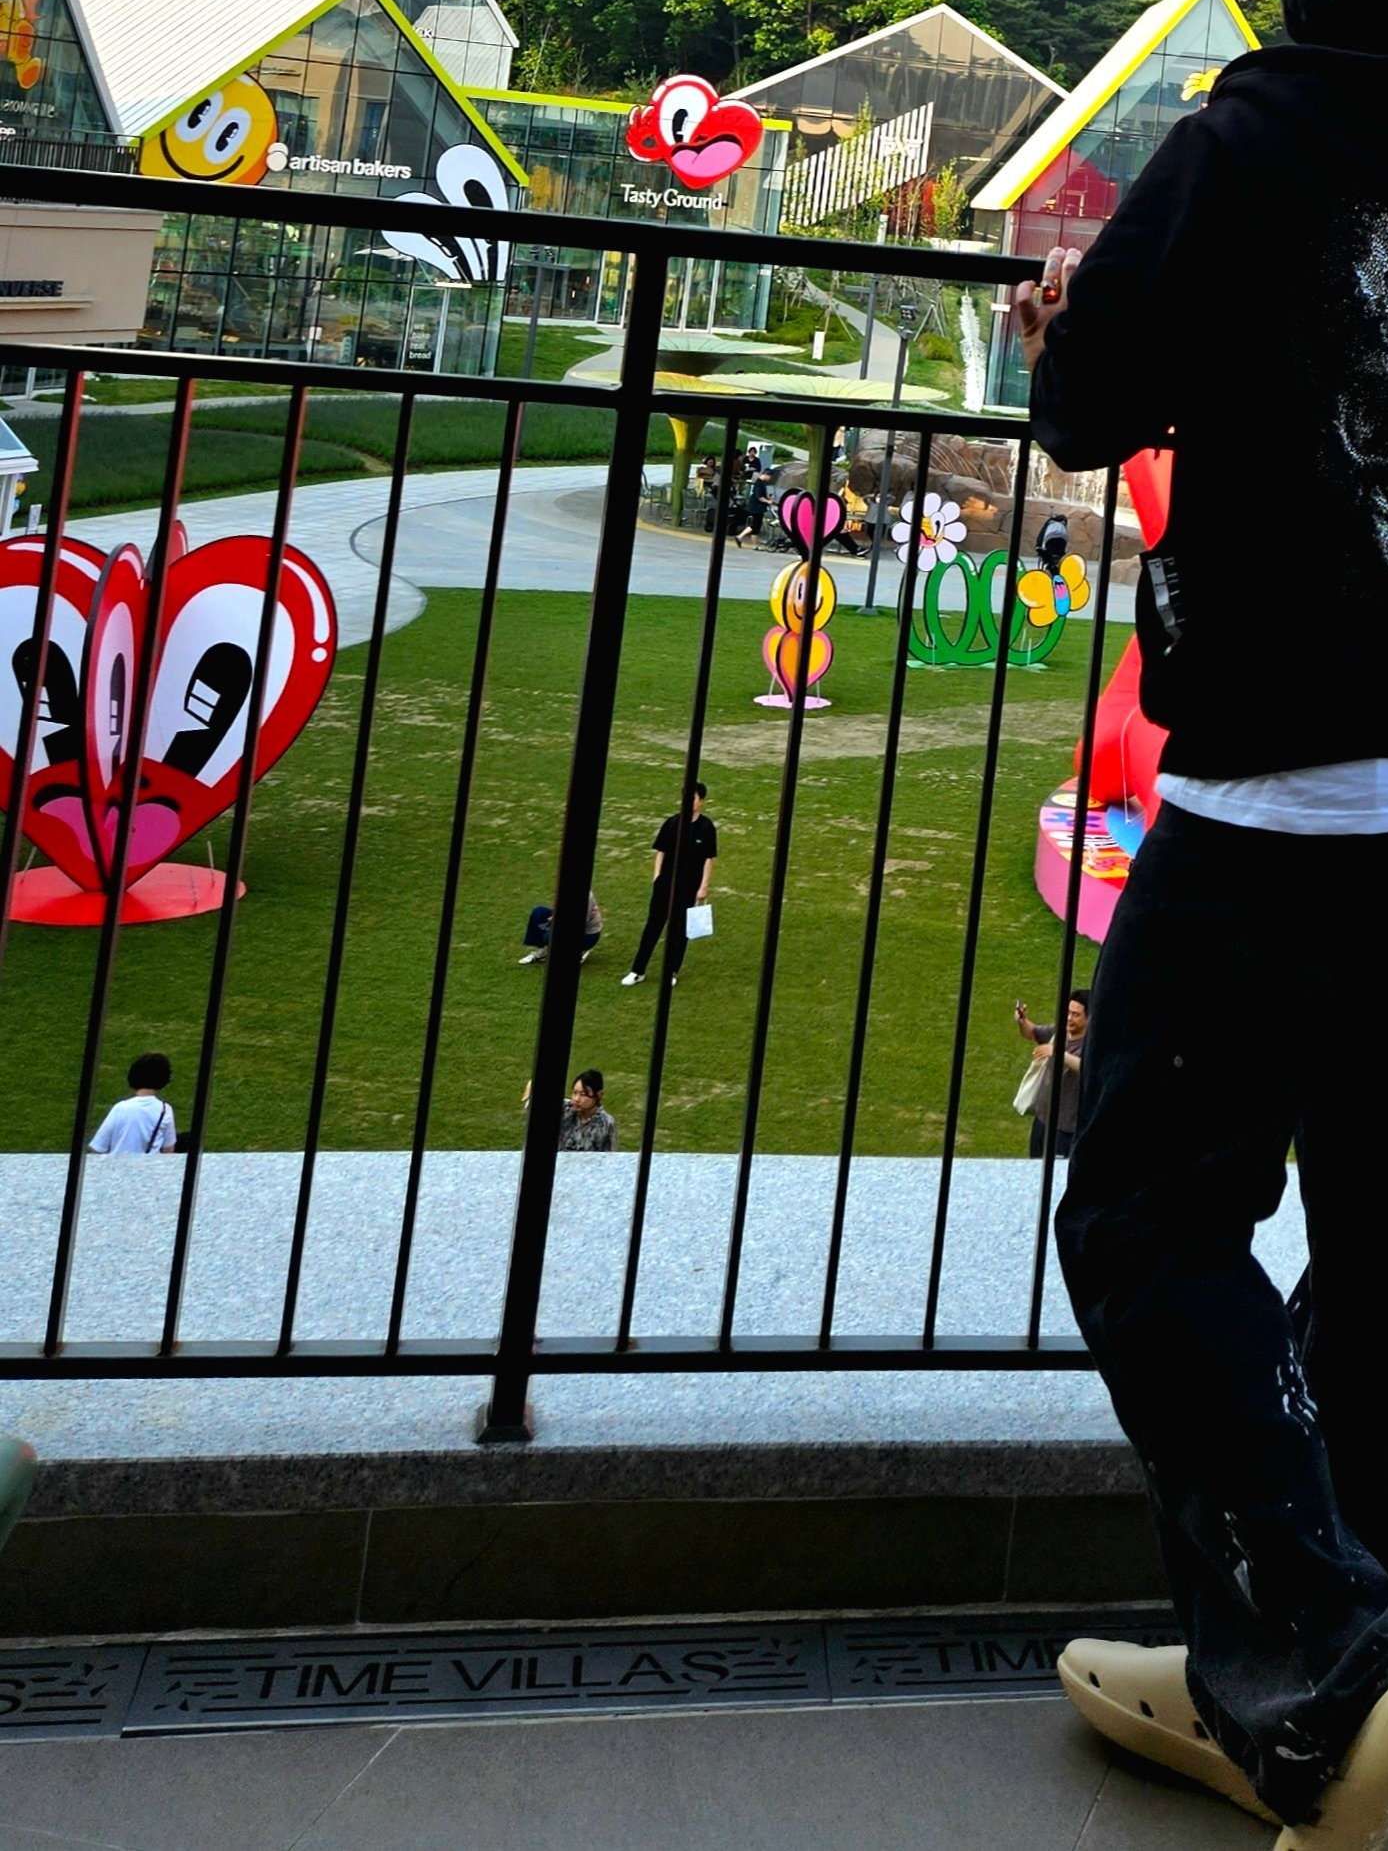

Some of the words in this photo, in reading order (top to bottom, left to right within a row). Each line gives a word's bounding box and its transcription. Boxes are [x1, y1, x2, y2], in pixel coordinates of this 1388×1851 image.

[289, 155, 351, 174] artisan
[352, 158, 411, 179] bakers
[620, 183, 662, 208] Tasty
[663, 188, 722, 210] Ground
[409, 351, 432, 360] bread
[246, 1660, 432, 1699] TIME
[451, 1650, 729, 1690] VILLAS
